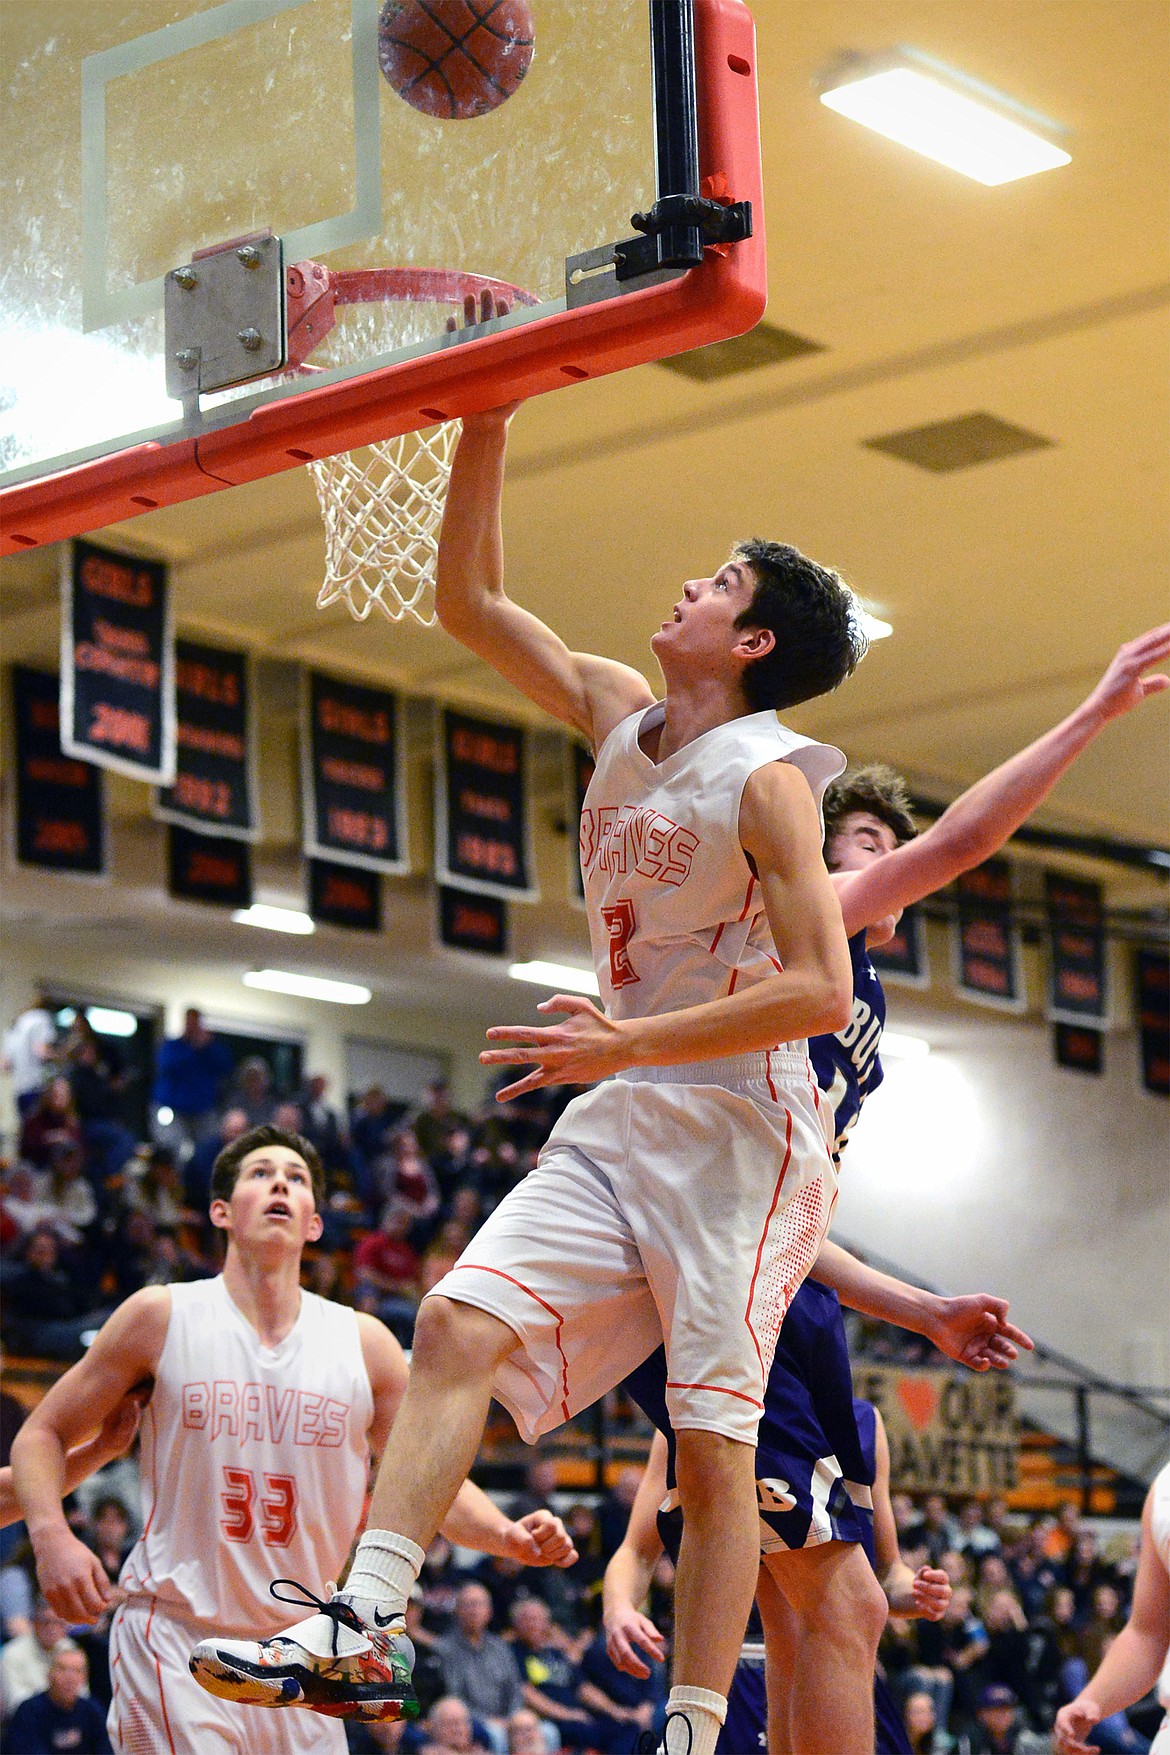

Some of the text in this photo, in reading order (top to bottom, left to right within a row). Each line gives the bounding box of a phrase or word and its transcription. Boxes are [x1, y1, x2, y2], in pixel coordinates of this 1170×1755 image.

[580, 805, 700, 887] BRAVES
[601, 898, 641, 990] 2
[182, 1380, 350, 1449] BRAVES
[940, 1378, 1014, 1430] OUR
[220, 1466, 298, 1548] 33
